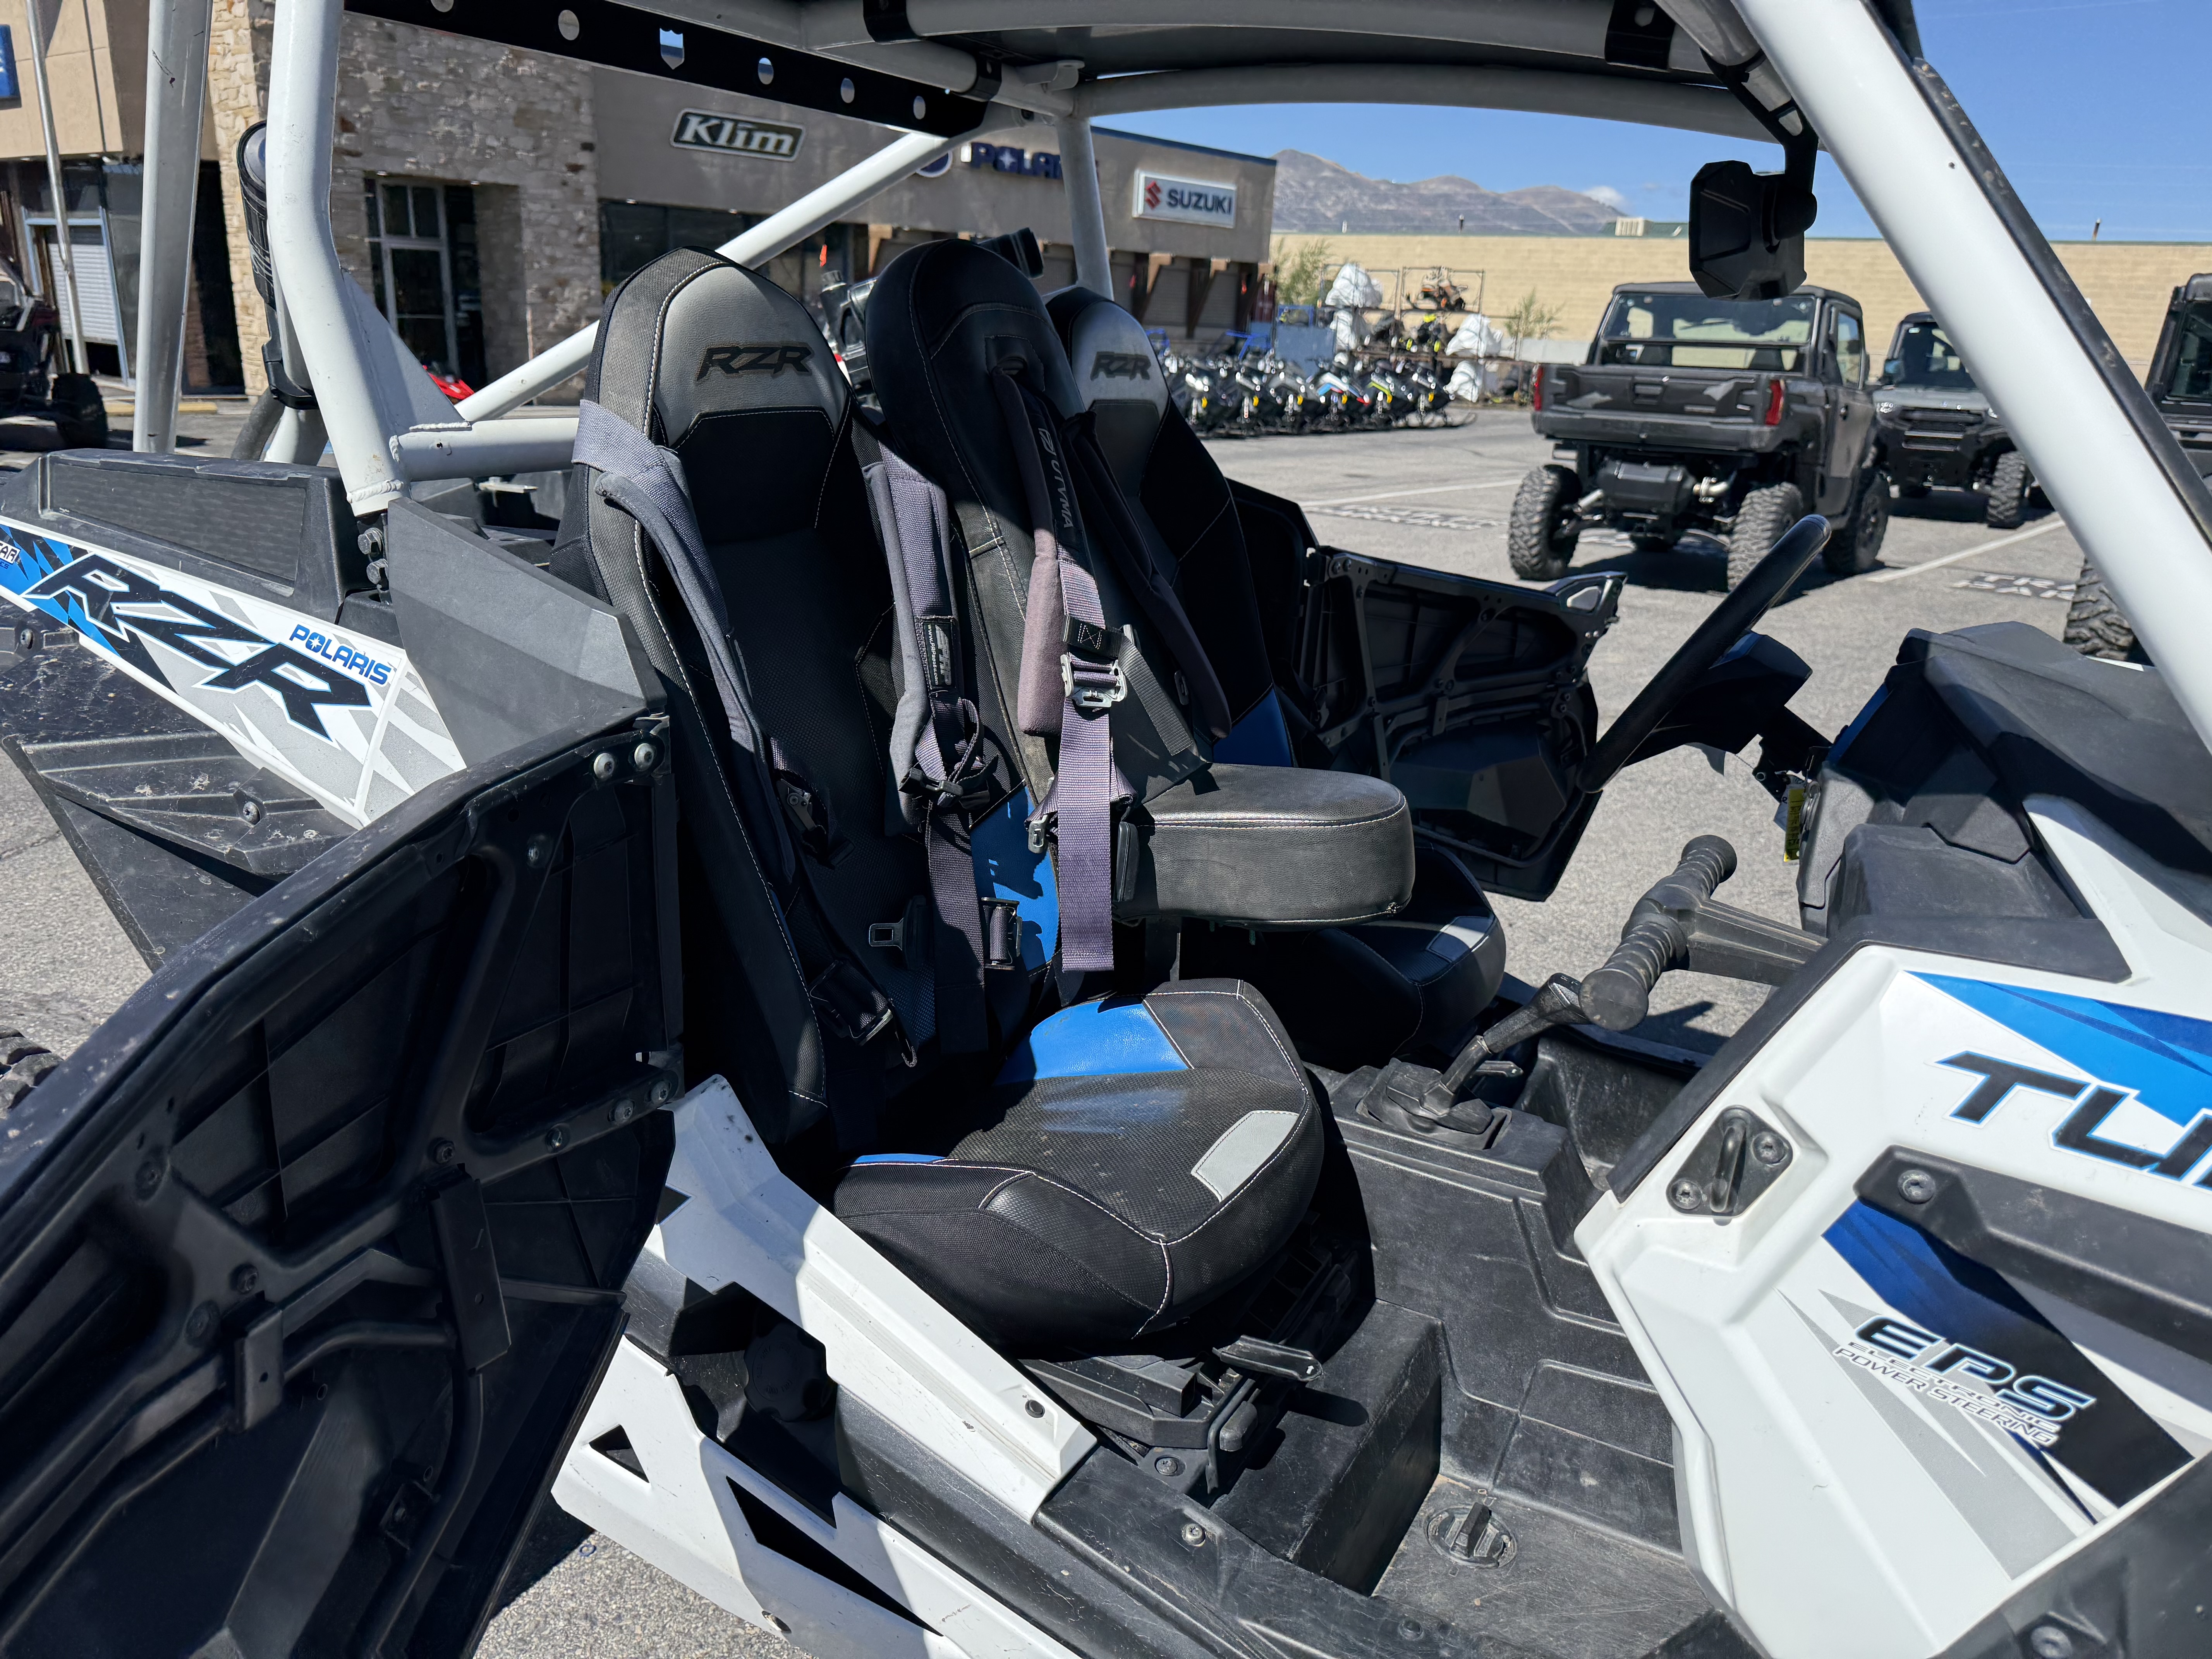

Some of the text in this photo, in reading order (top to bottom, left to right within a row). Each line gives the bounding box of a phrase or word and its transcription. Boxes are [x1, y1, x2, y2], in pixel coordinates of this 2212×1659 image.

[680, 115, 795, 155] Klim
[971, 142, 1100, 185] POLA
[1166, 189, 1232, 215] SUZUKI
[696, 343, 814, 381] RZR
[1090, 352, 1151, 381] RZR
[26, 554, 371, 739] RZR
[289, 624, 392, 685] POLARIS
[1936, 1050, 2212, 1190] TU
[1835, 1348, 2056, 1445] POWER STEERING
[1849, 1341, 2061, 1432] ELECTRONIC
[1855, 1316, 2097, 1420] EPS
